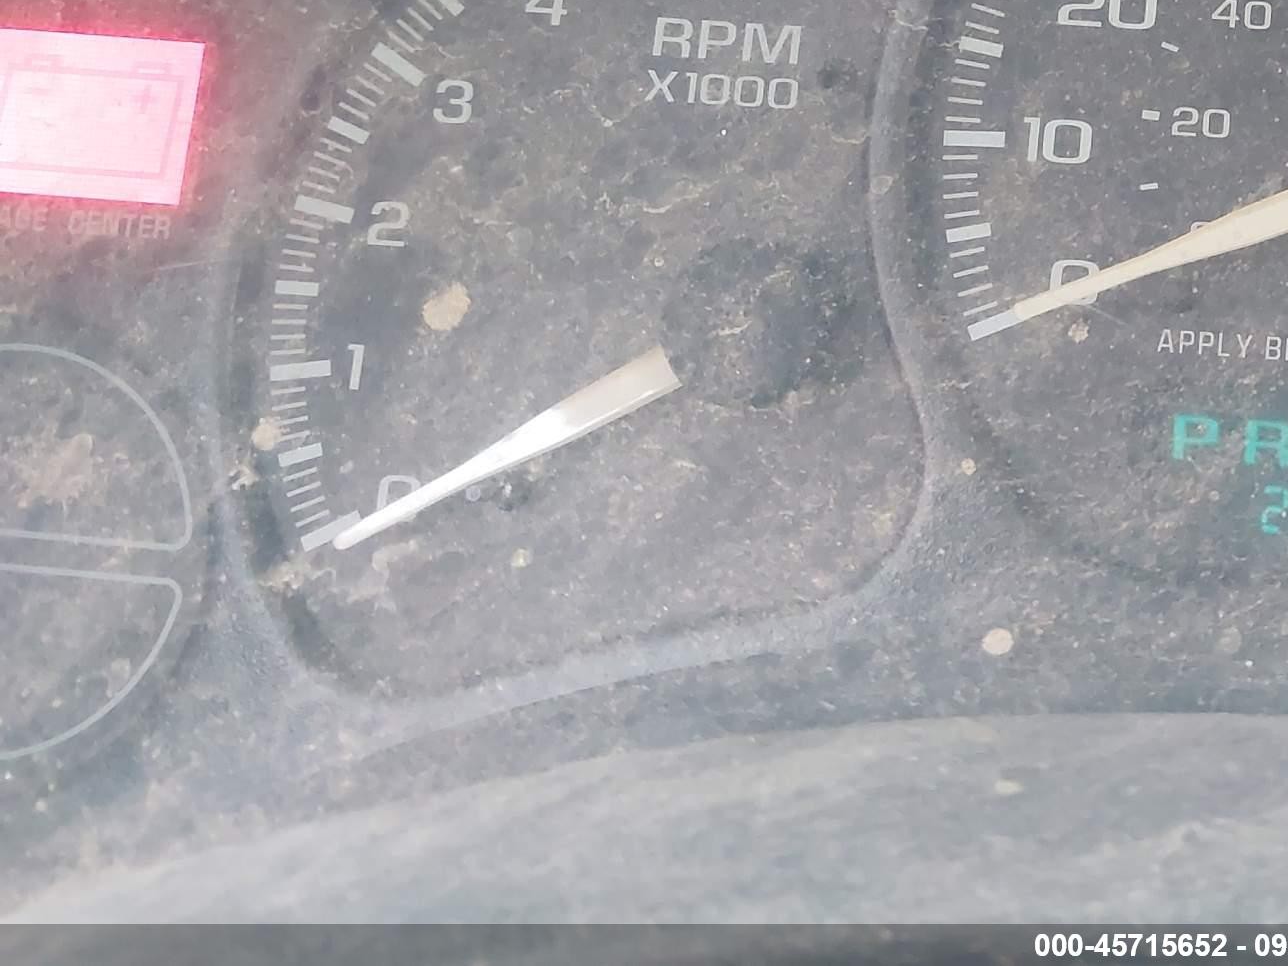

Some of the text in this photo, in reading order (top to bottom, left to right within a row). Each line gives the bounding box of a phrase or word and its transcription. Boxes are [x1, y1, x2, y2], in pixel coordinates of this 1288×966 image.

[1211, 0, 1273, 31] 40
[652, 17, 803, 65] RPM
[432, 79, 474, 126] 3
[644, 68, 800, 110] X1000
[1023, 116, 1094, 165] 10
[1171, 106, 1232, 139] 20
[67, 210, 171, 239] CENTER
[366, 200, 410, 247] 2
[346, 342, 366, 391] 1
[1156, 329, 1254, 359] APPLY
[1171, 413, 1221, 461] P
